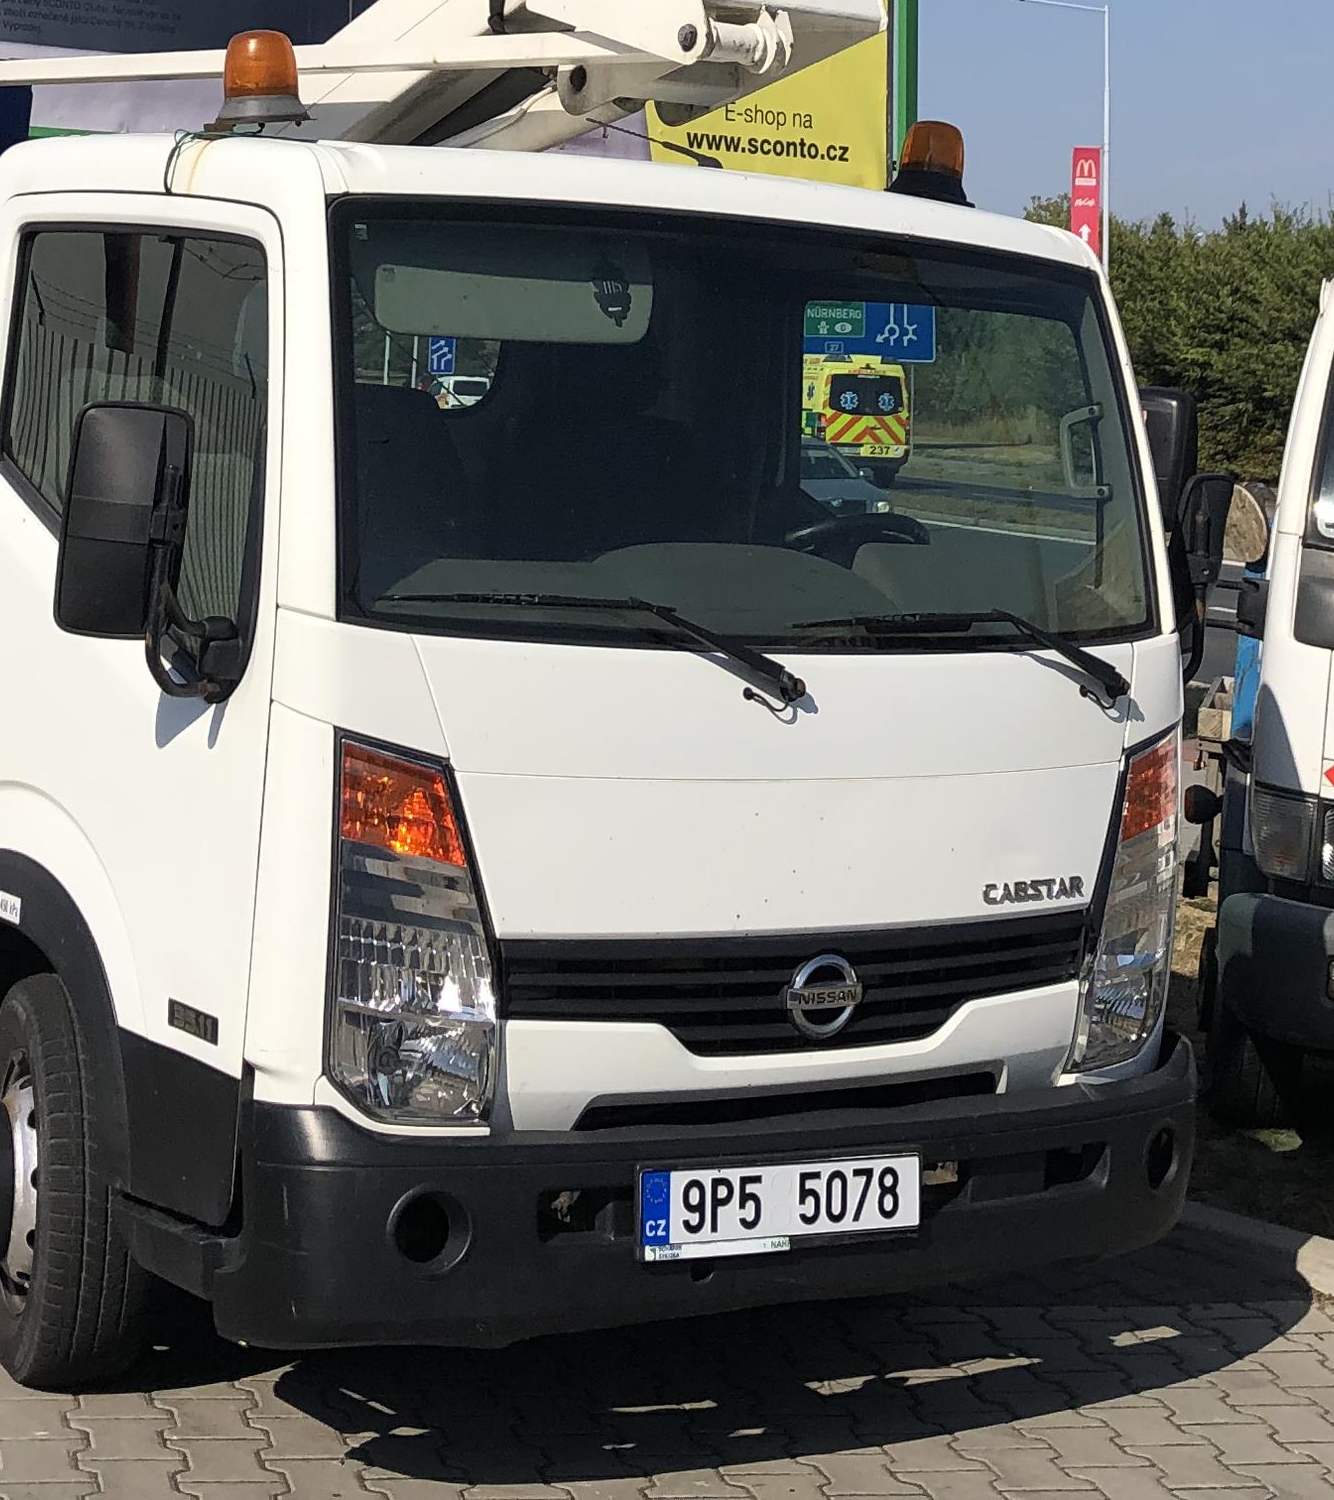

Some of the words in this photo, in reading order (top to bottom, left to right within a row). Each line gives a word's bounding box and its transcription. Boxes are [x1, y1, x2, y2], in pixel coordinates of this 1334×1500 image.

[724, 101, 787, 131] E-shop
[792, 112, 813, 129] na
[686, 131, 850, 163] www.sconto.cz
[807, 306, 862, 319] NÜRNBERG
[869, 445, 890, 455] 237
[982, 875, 1085, 906] CABSTAR
[798, 989, 857, 1005] NISSAN
[682, 1174, 763, 1235] 9P5
[798, 1166, 900, 1226] 5078
[645, 1220, 666, 1236] CZ
